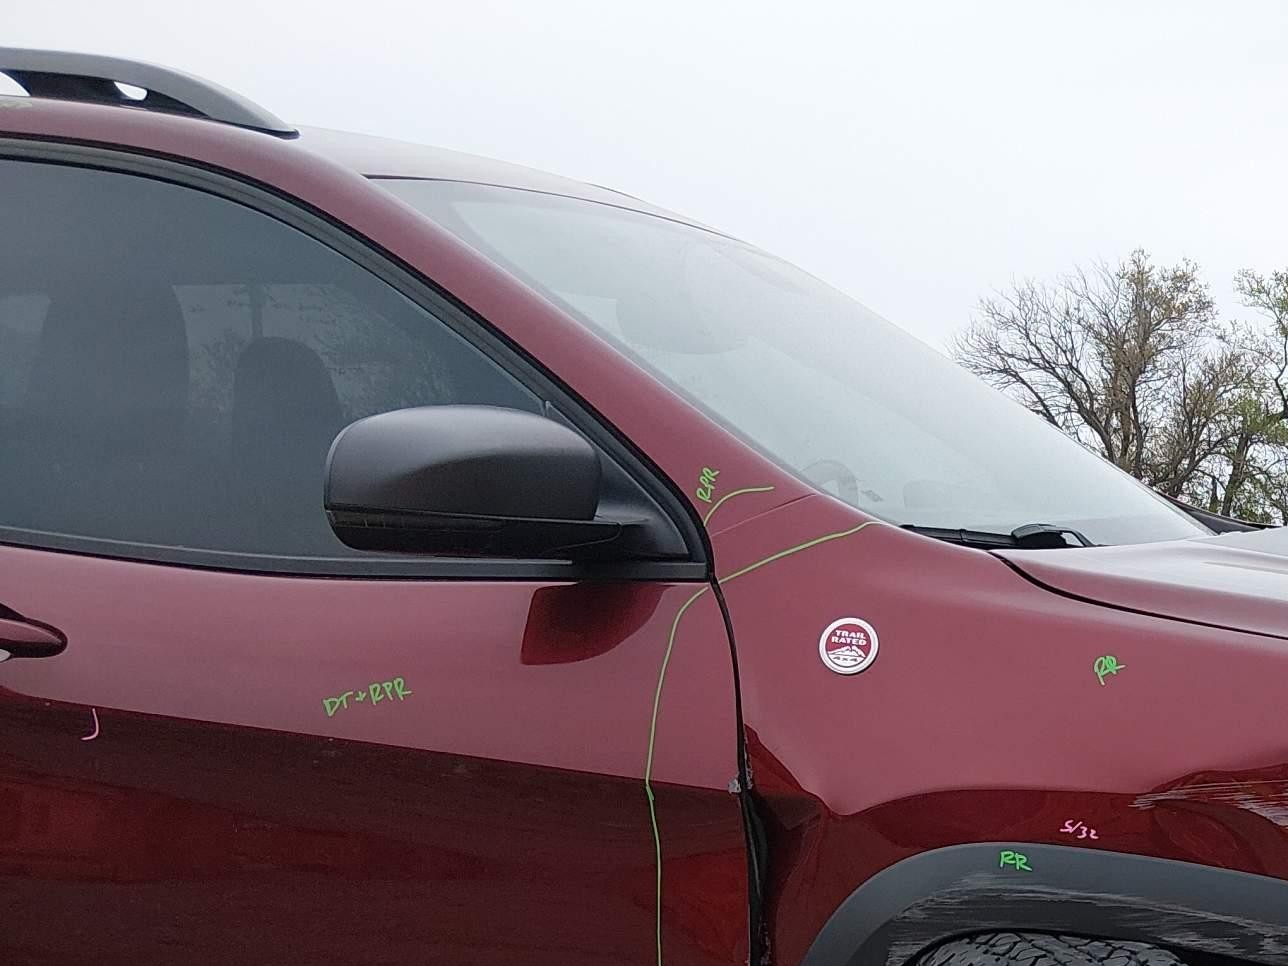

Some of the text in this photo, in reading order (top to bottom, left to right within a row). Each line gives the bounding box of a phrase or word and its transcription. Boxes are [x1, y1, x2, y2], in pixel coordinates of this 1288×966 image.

[835, 629, 866, 640] TRAIL
[831, 636, 867, 646] RATED
[999, 850, 1032, 872] RR
